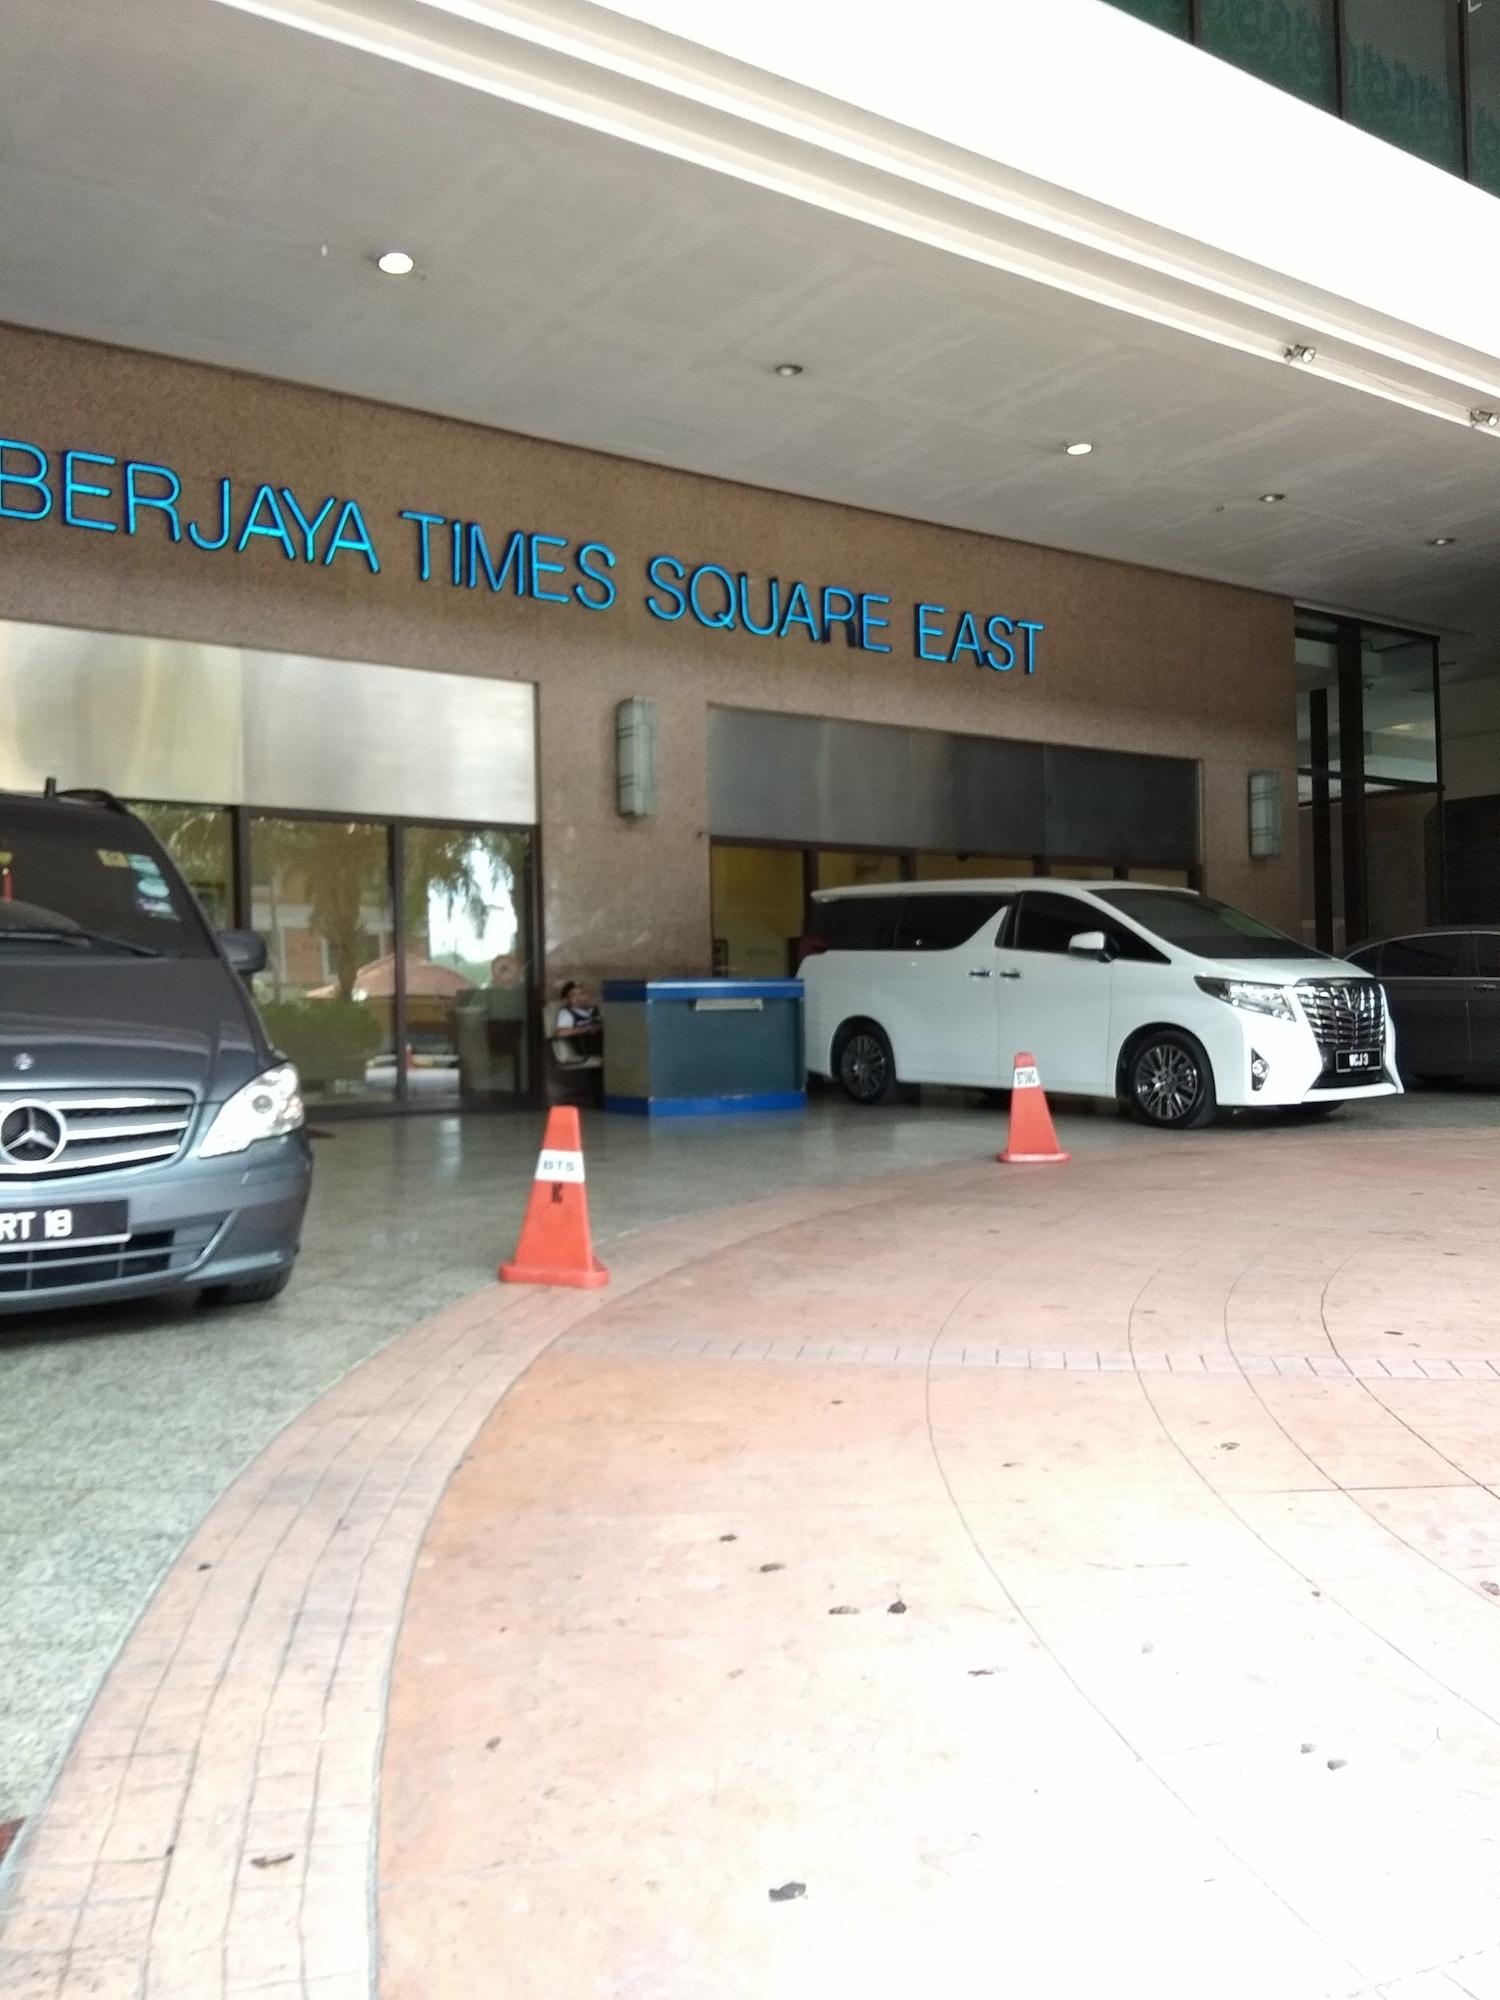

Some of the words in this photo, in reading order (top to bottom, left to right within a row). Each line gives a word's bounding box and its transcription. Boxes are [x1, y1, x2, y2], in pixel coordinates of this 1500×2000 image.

[0, 438, 381, 574] BERJAYA
[400, 509, 617, 611] TIMES
[646, 554, 893, 654] SQUARE
[914, 602, 1046, 676] EAST
[543, 1159, 576, 1172] BTS
